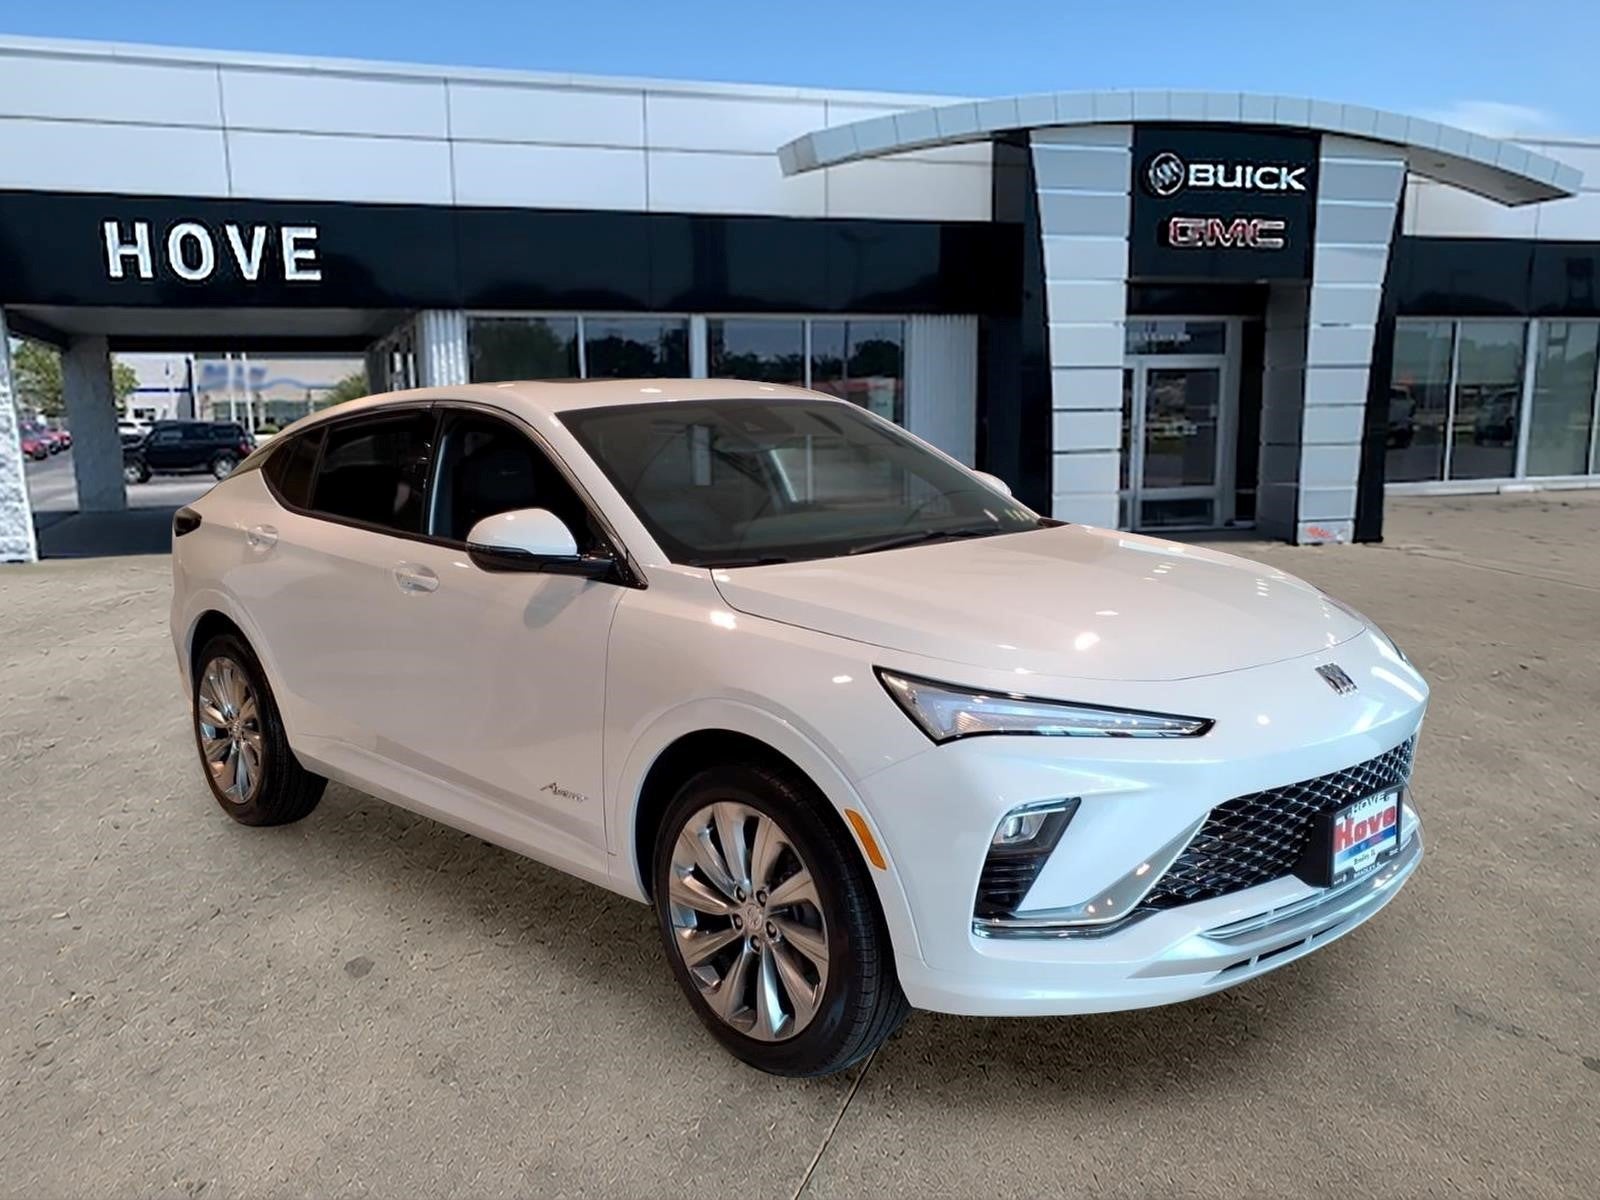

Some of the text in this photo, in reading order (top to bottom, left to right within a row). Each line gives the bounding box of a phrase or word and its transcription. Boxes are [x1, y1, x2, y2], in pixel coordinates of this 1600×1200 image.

[1188, 164, 1306, 190] BUICK
[1169, 217, 1285, 248] GMC
[104, 221, 322, 280] HOVE
